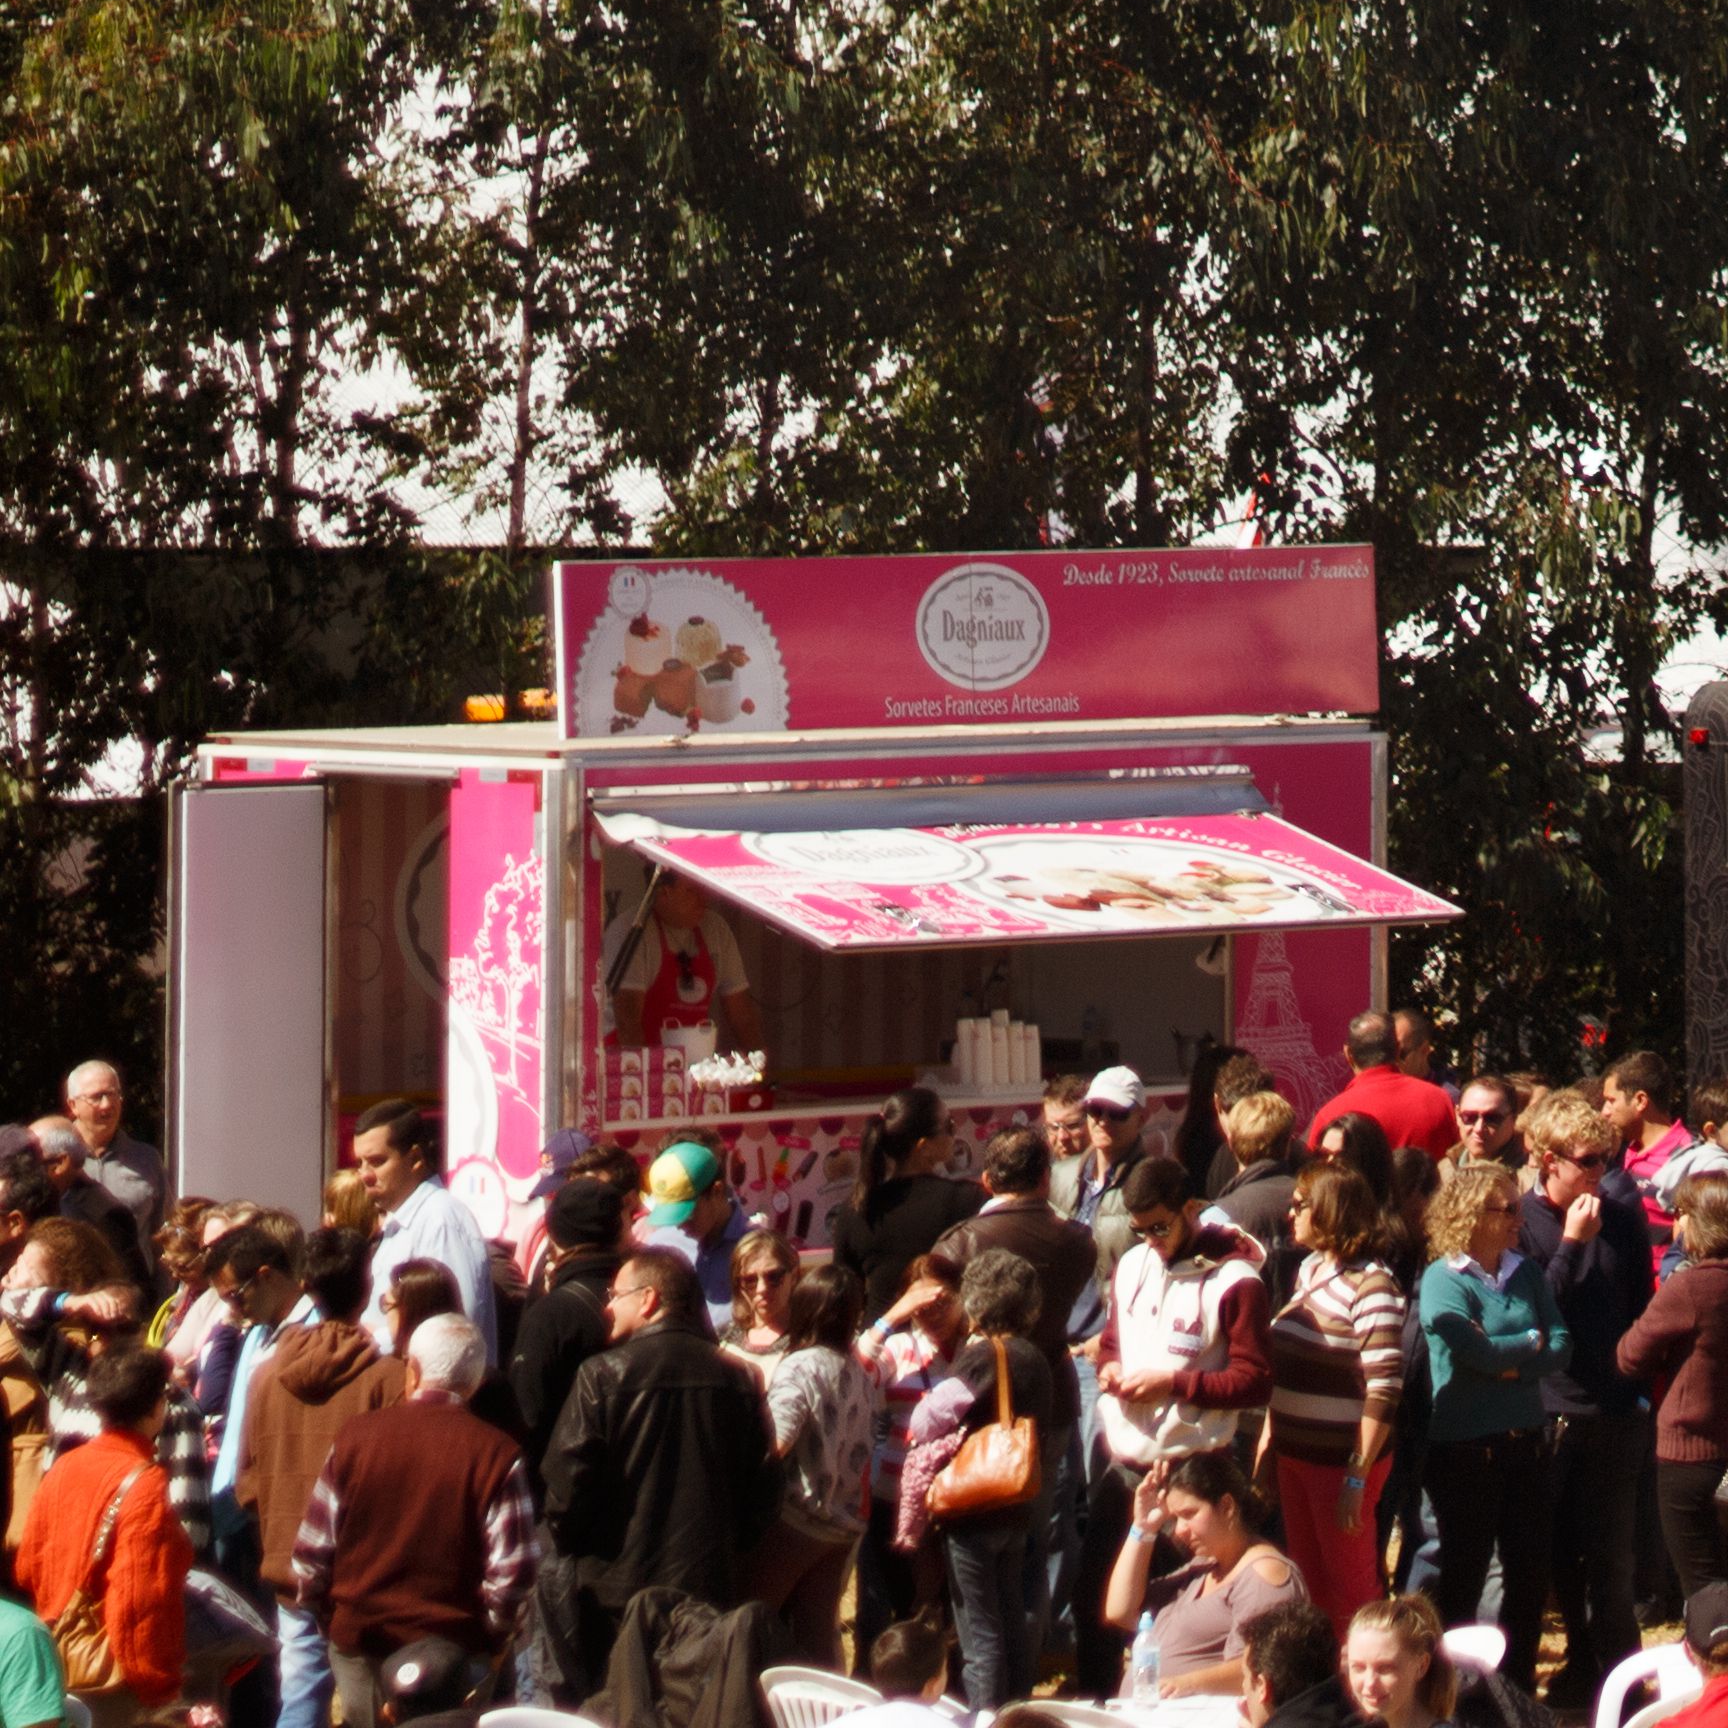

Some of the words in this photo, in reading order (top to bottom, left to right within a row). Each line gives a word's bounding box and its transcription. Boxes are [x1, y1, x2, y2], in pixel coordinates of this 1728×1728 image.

[1063, 562, 1113, 586] Desde
[1117, 562, 1163, 587] 1923,
[1168, 561, 1225, 584] Sorvete
[1228, 559, 1305, 582] artesanal
[1309, 558, 1370, 579] Francês
[942, 609, 1026, 649] Dagniaux
[884, 697, 943, 719] Sorvetes
[945, 694, 1009, 716] Franceses
[1011, 691, 1081, 713] Artesanais
